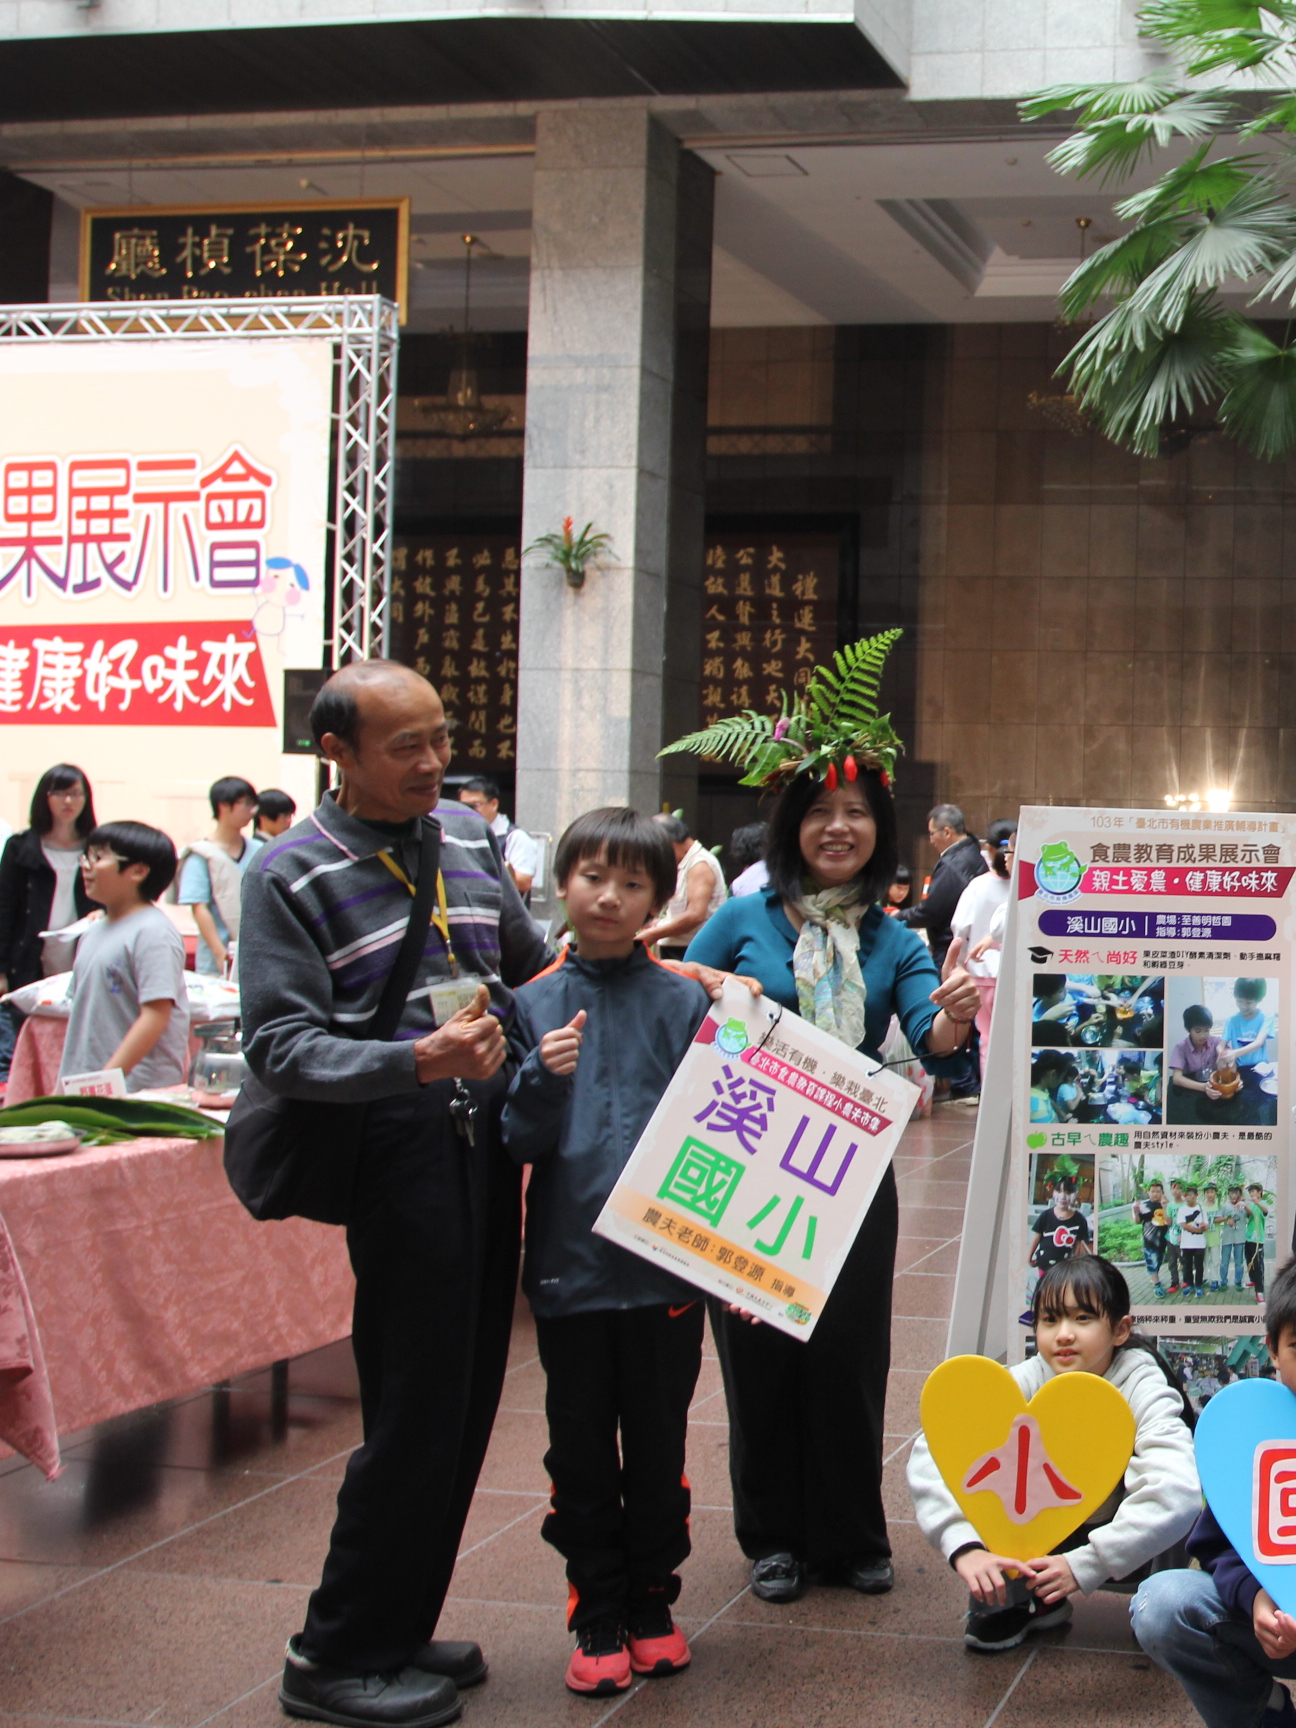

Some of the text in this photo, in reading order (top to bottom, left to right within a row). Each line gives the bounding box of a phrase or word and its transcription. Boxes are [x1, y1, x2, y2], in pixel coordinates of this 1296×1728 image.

[0, 450, 273, 598] 果展示會
[0, 633, 257, 714] 健康好味來
[762, 544, 787, 725] 大道之行也天
[1090, 843, 1281, 864] 食農教育成果展示會
[1066, 915, 1136, 935] 溪山國小
[694, 1064, 859, 1197] 溪山
[656, 1135, 818, 1260] 國小
[961, 1424, 1082, 1514] 小
